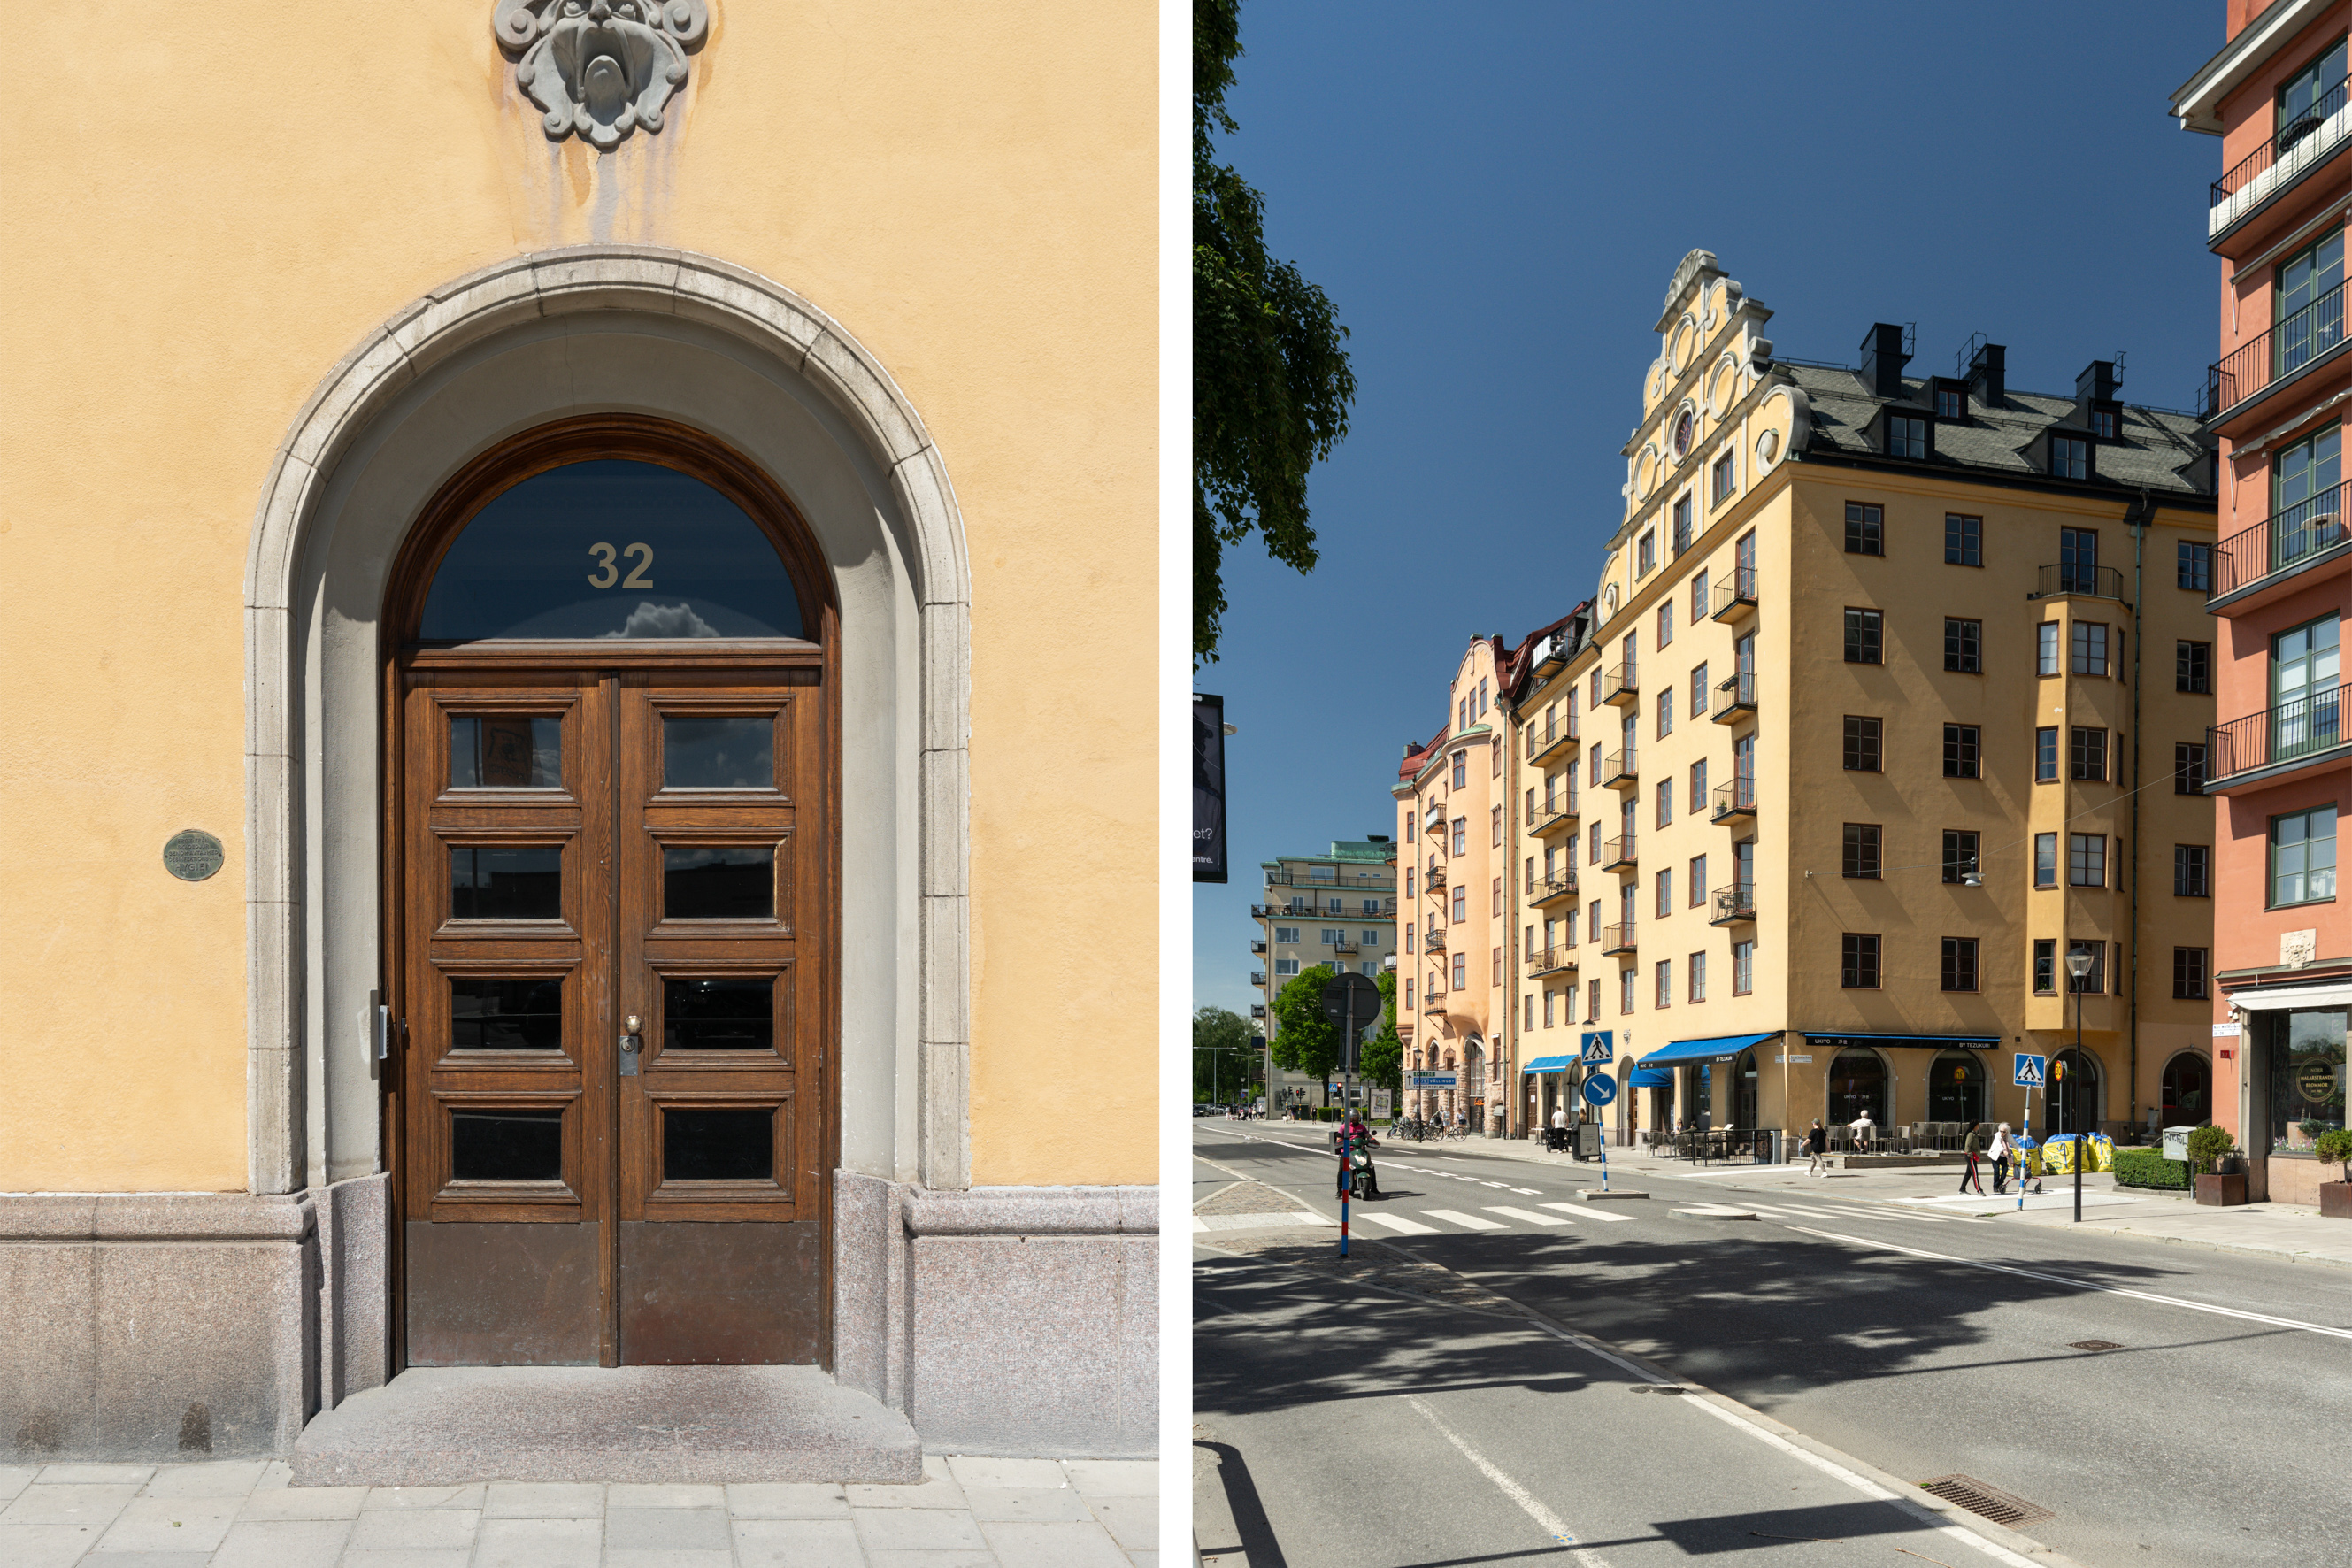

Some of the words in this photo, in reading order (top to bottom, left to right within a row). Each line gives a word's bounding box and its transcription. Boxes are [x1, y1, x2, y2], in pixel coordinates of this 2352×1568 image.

[586, 544, 648, 589] 32
[1193, 828, 1213, 840] et?
[2056, 1065, 2061, 1076] 30
